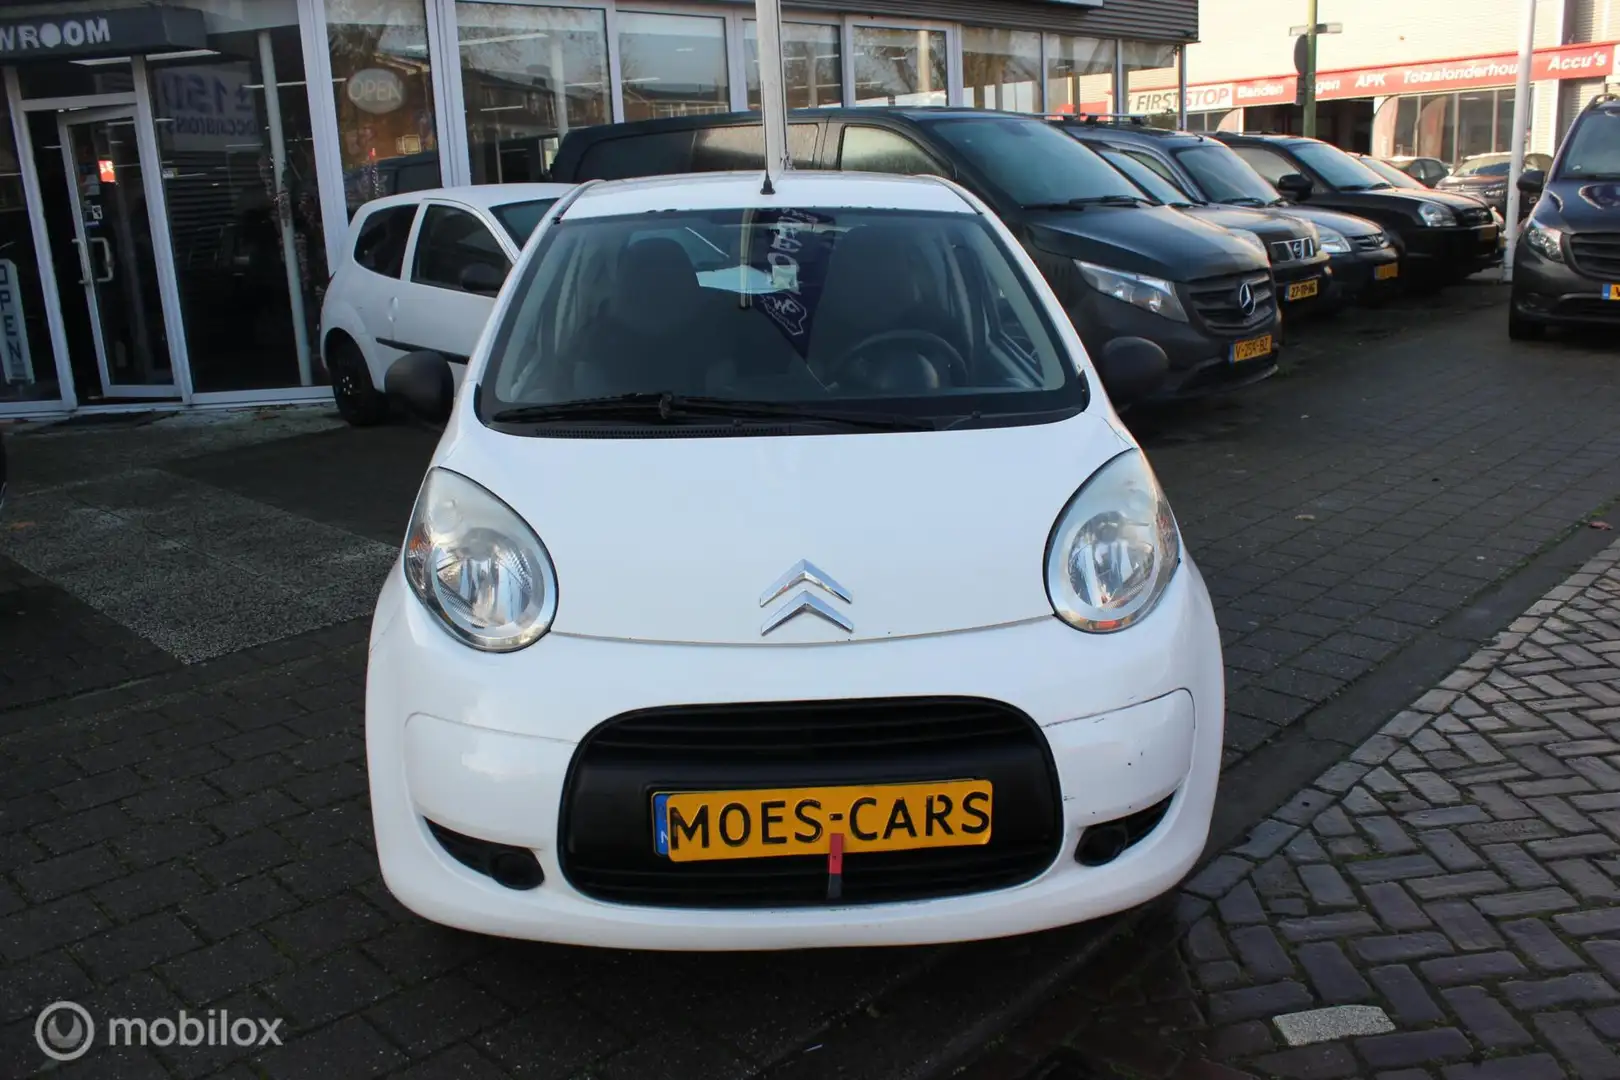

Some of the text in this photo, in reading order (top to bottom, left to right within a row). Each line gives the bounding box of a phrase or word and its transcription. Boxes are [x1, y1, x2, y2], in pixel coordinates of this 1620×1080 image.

[347, 79, 405, 101] OPEN
[1237, 83, 1284, 98] Banden
[1355, 72, 1386, 88] APK
[1403, 61, 1519, 84] Totaalonderhou
[1547, 51, 1607, 71] Accu's
[669, 791, 990, 850] MOES-CARS
